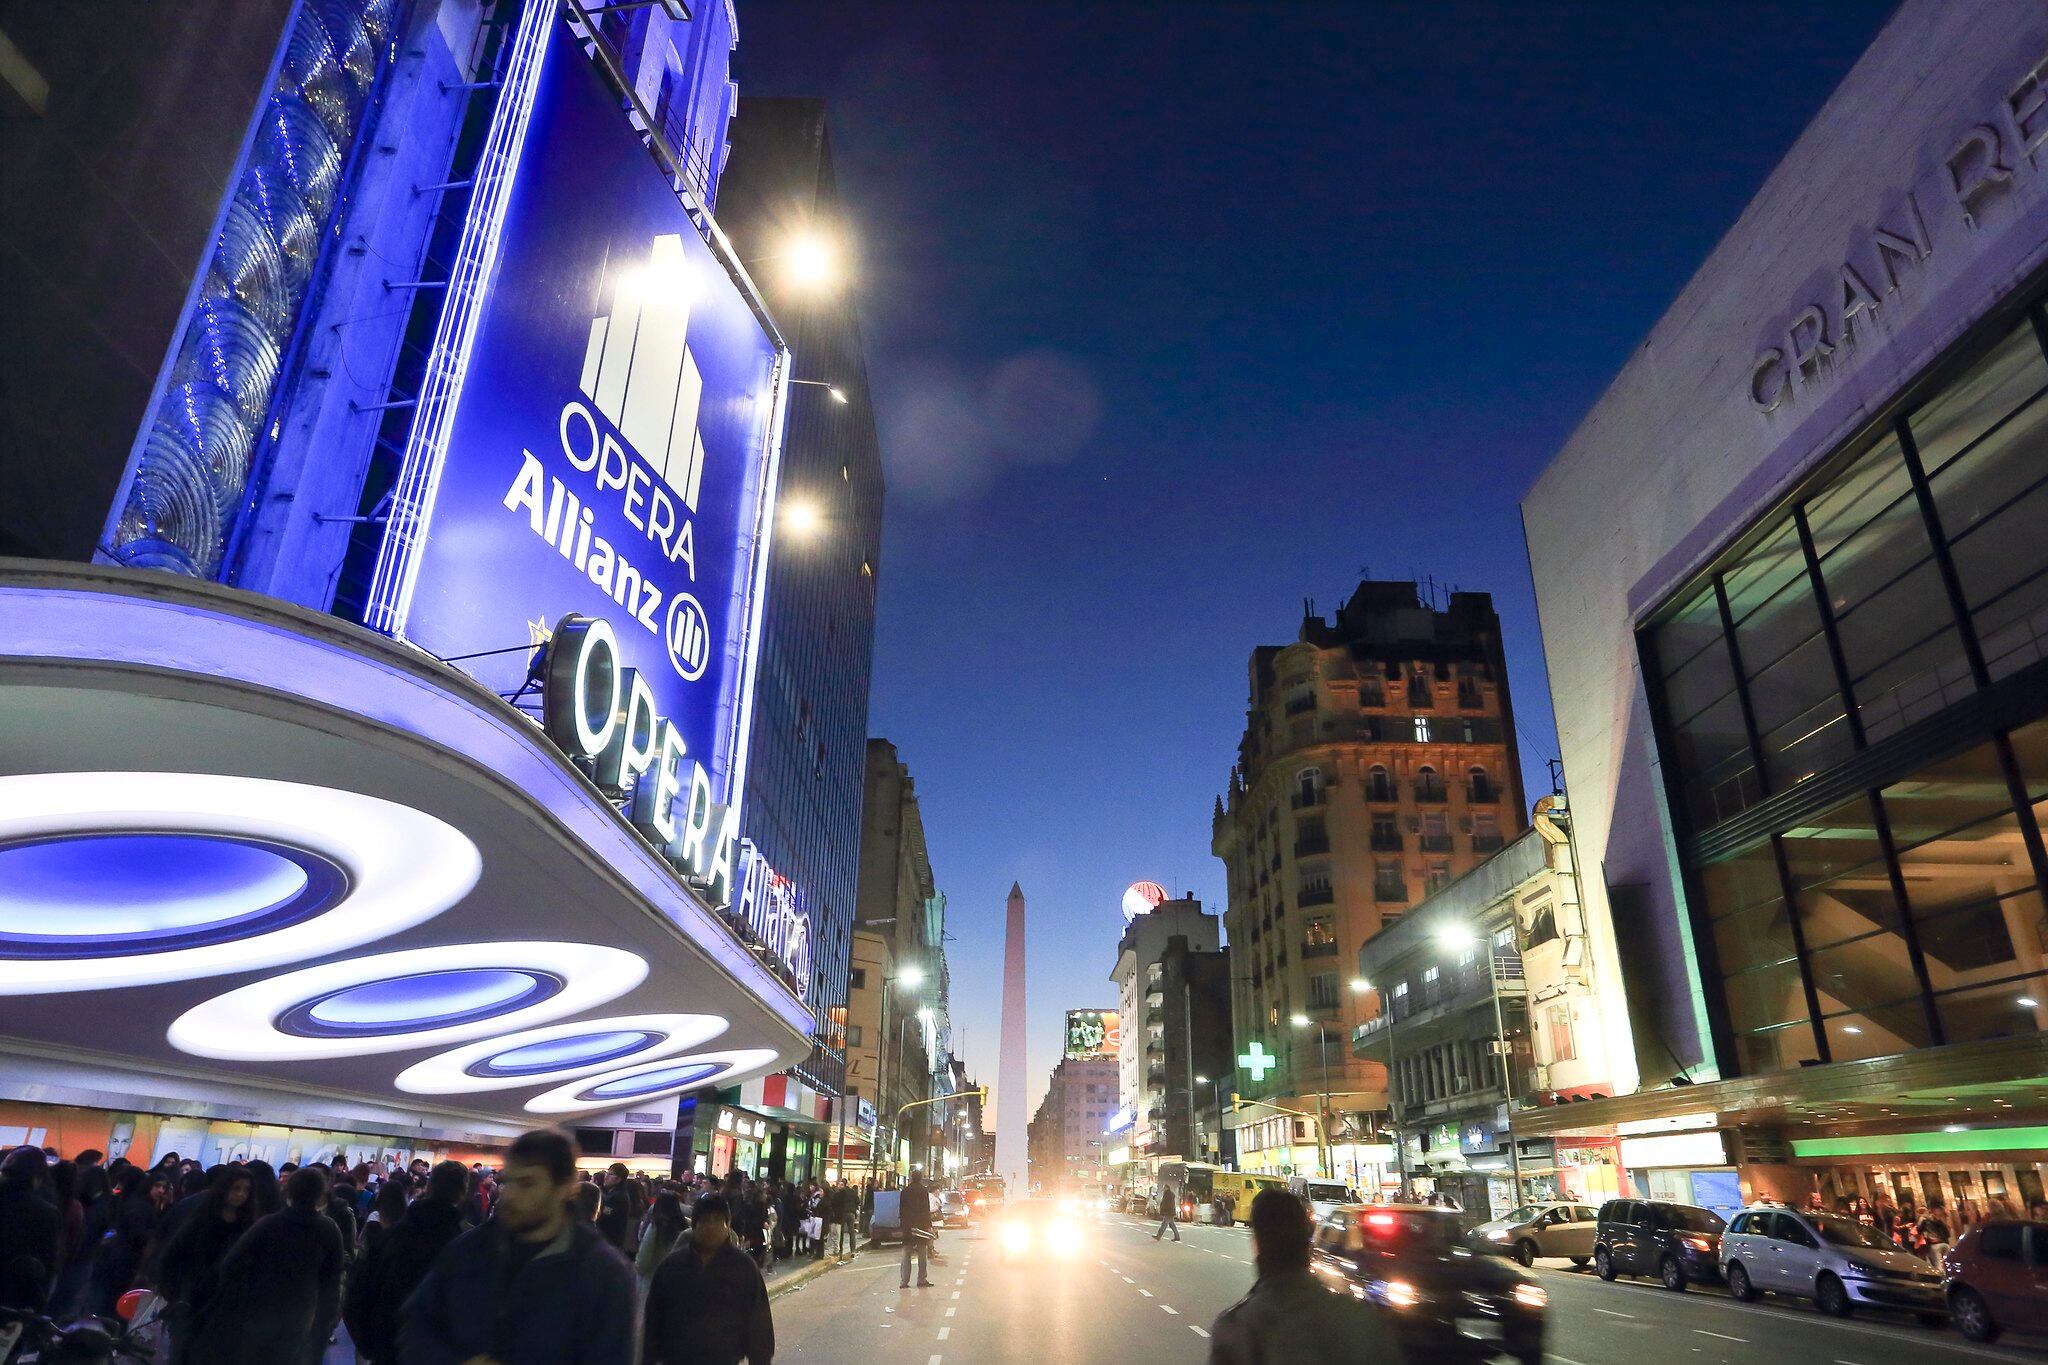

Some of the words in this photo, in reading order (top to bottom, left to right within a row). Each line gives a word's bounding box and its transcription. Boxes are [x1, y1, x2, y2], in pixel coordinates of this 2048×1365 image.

[1746, 192, 1934, 414] GRAN
[502, 447, 663, 635] Allianz
[559, 401, 696, 582] OPERA
[574, 617, 740, 905] OPERA
